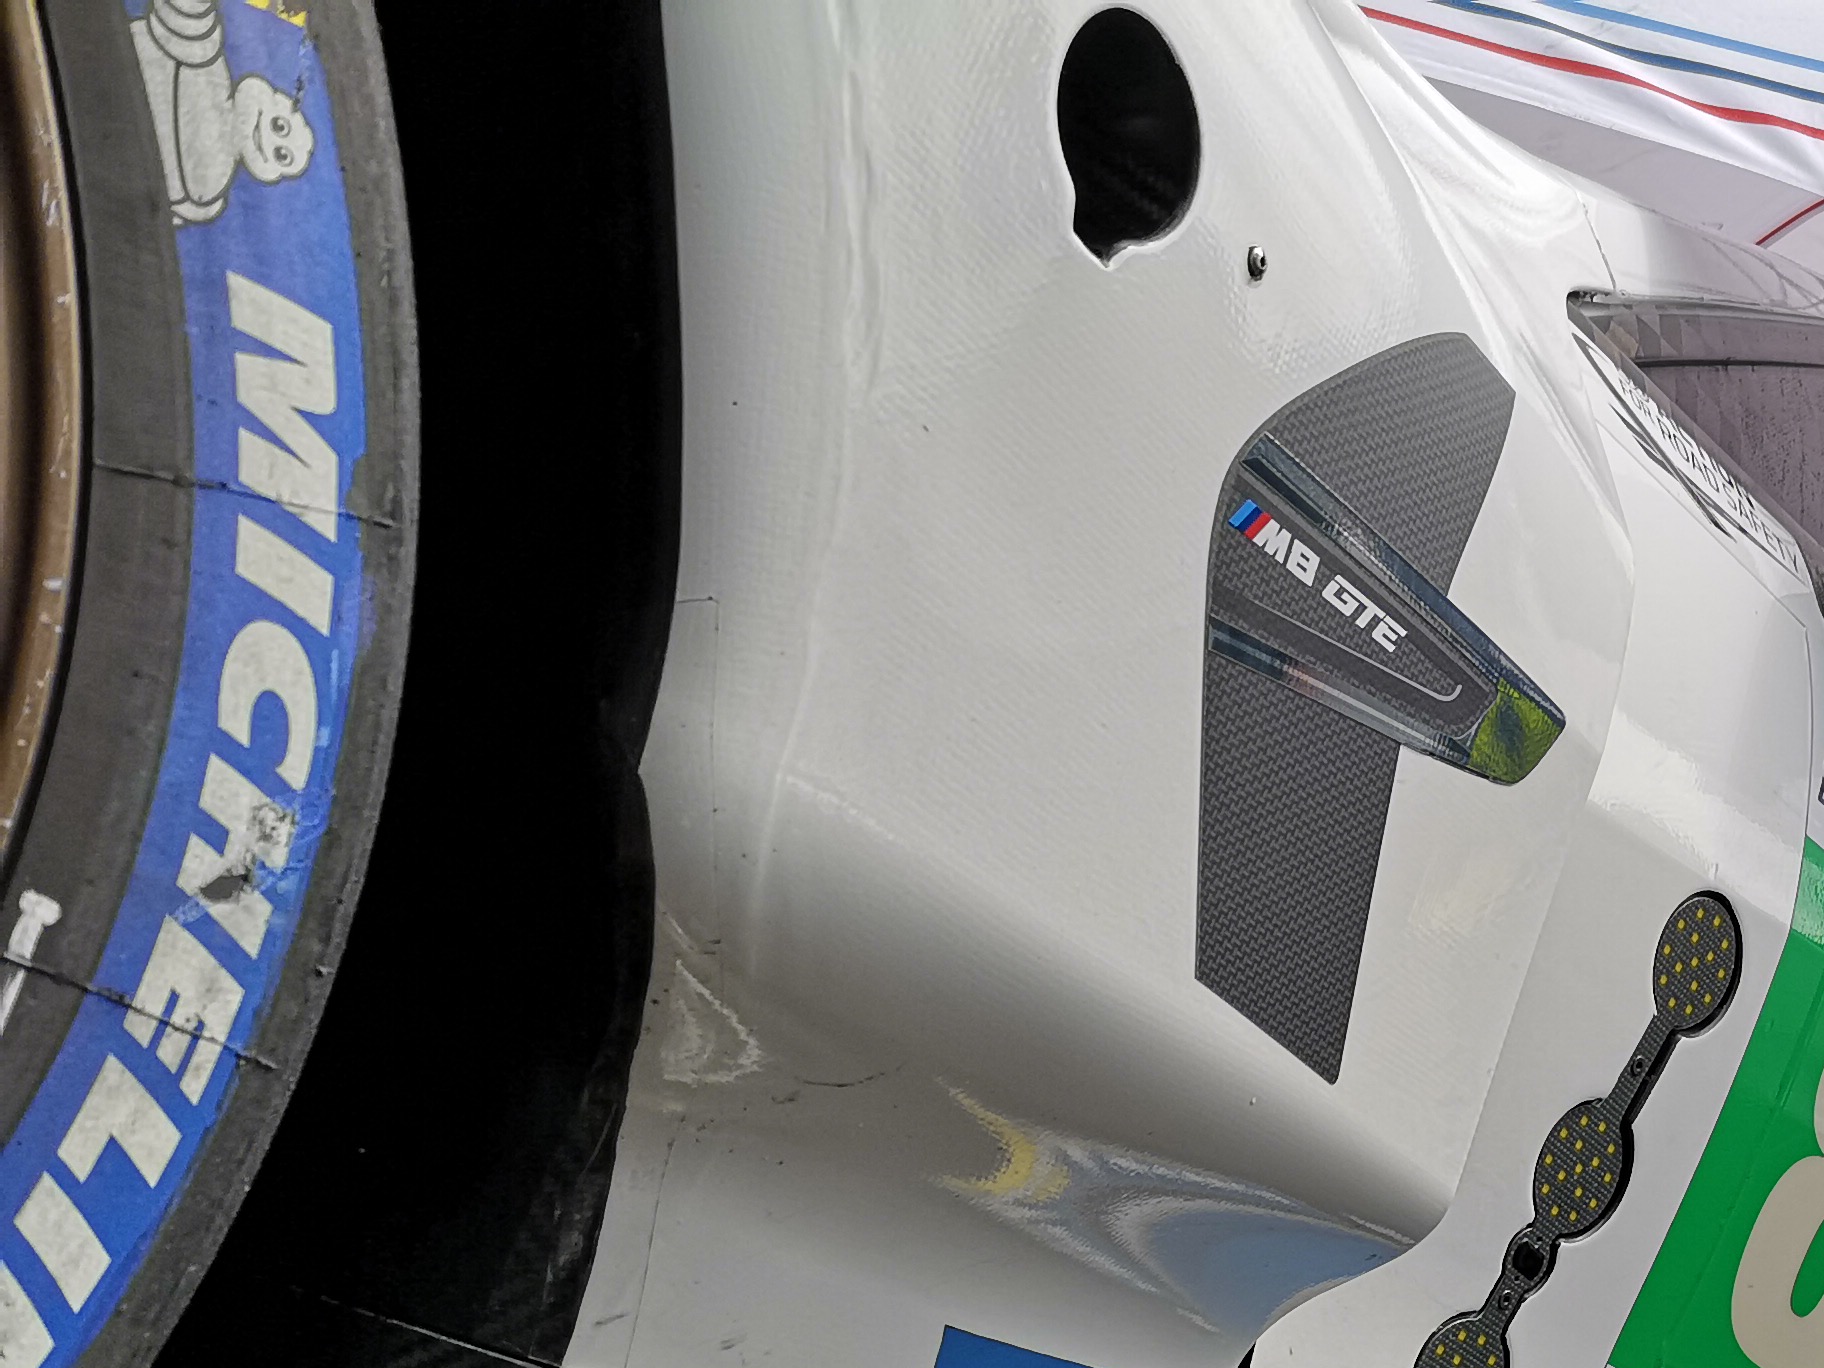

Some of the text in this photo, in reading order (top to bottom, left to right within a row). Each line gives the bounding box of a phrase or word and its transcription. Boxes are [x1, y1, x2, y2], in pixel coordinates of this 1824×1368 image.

[1657, 417, 1720, 493] ROAD
[1723, 483, 1799, 573] SAFETY
[1251, 518, 1408, 654] M8 GTE
